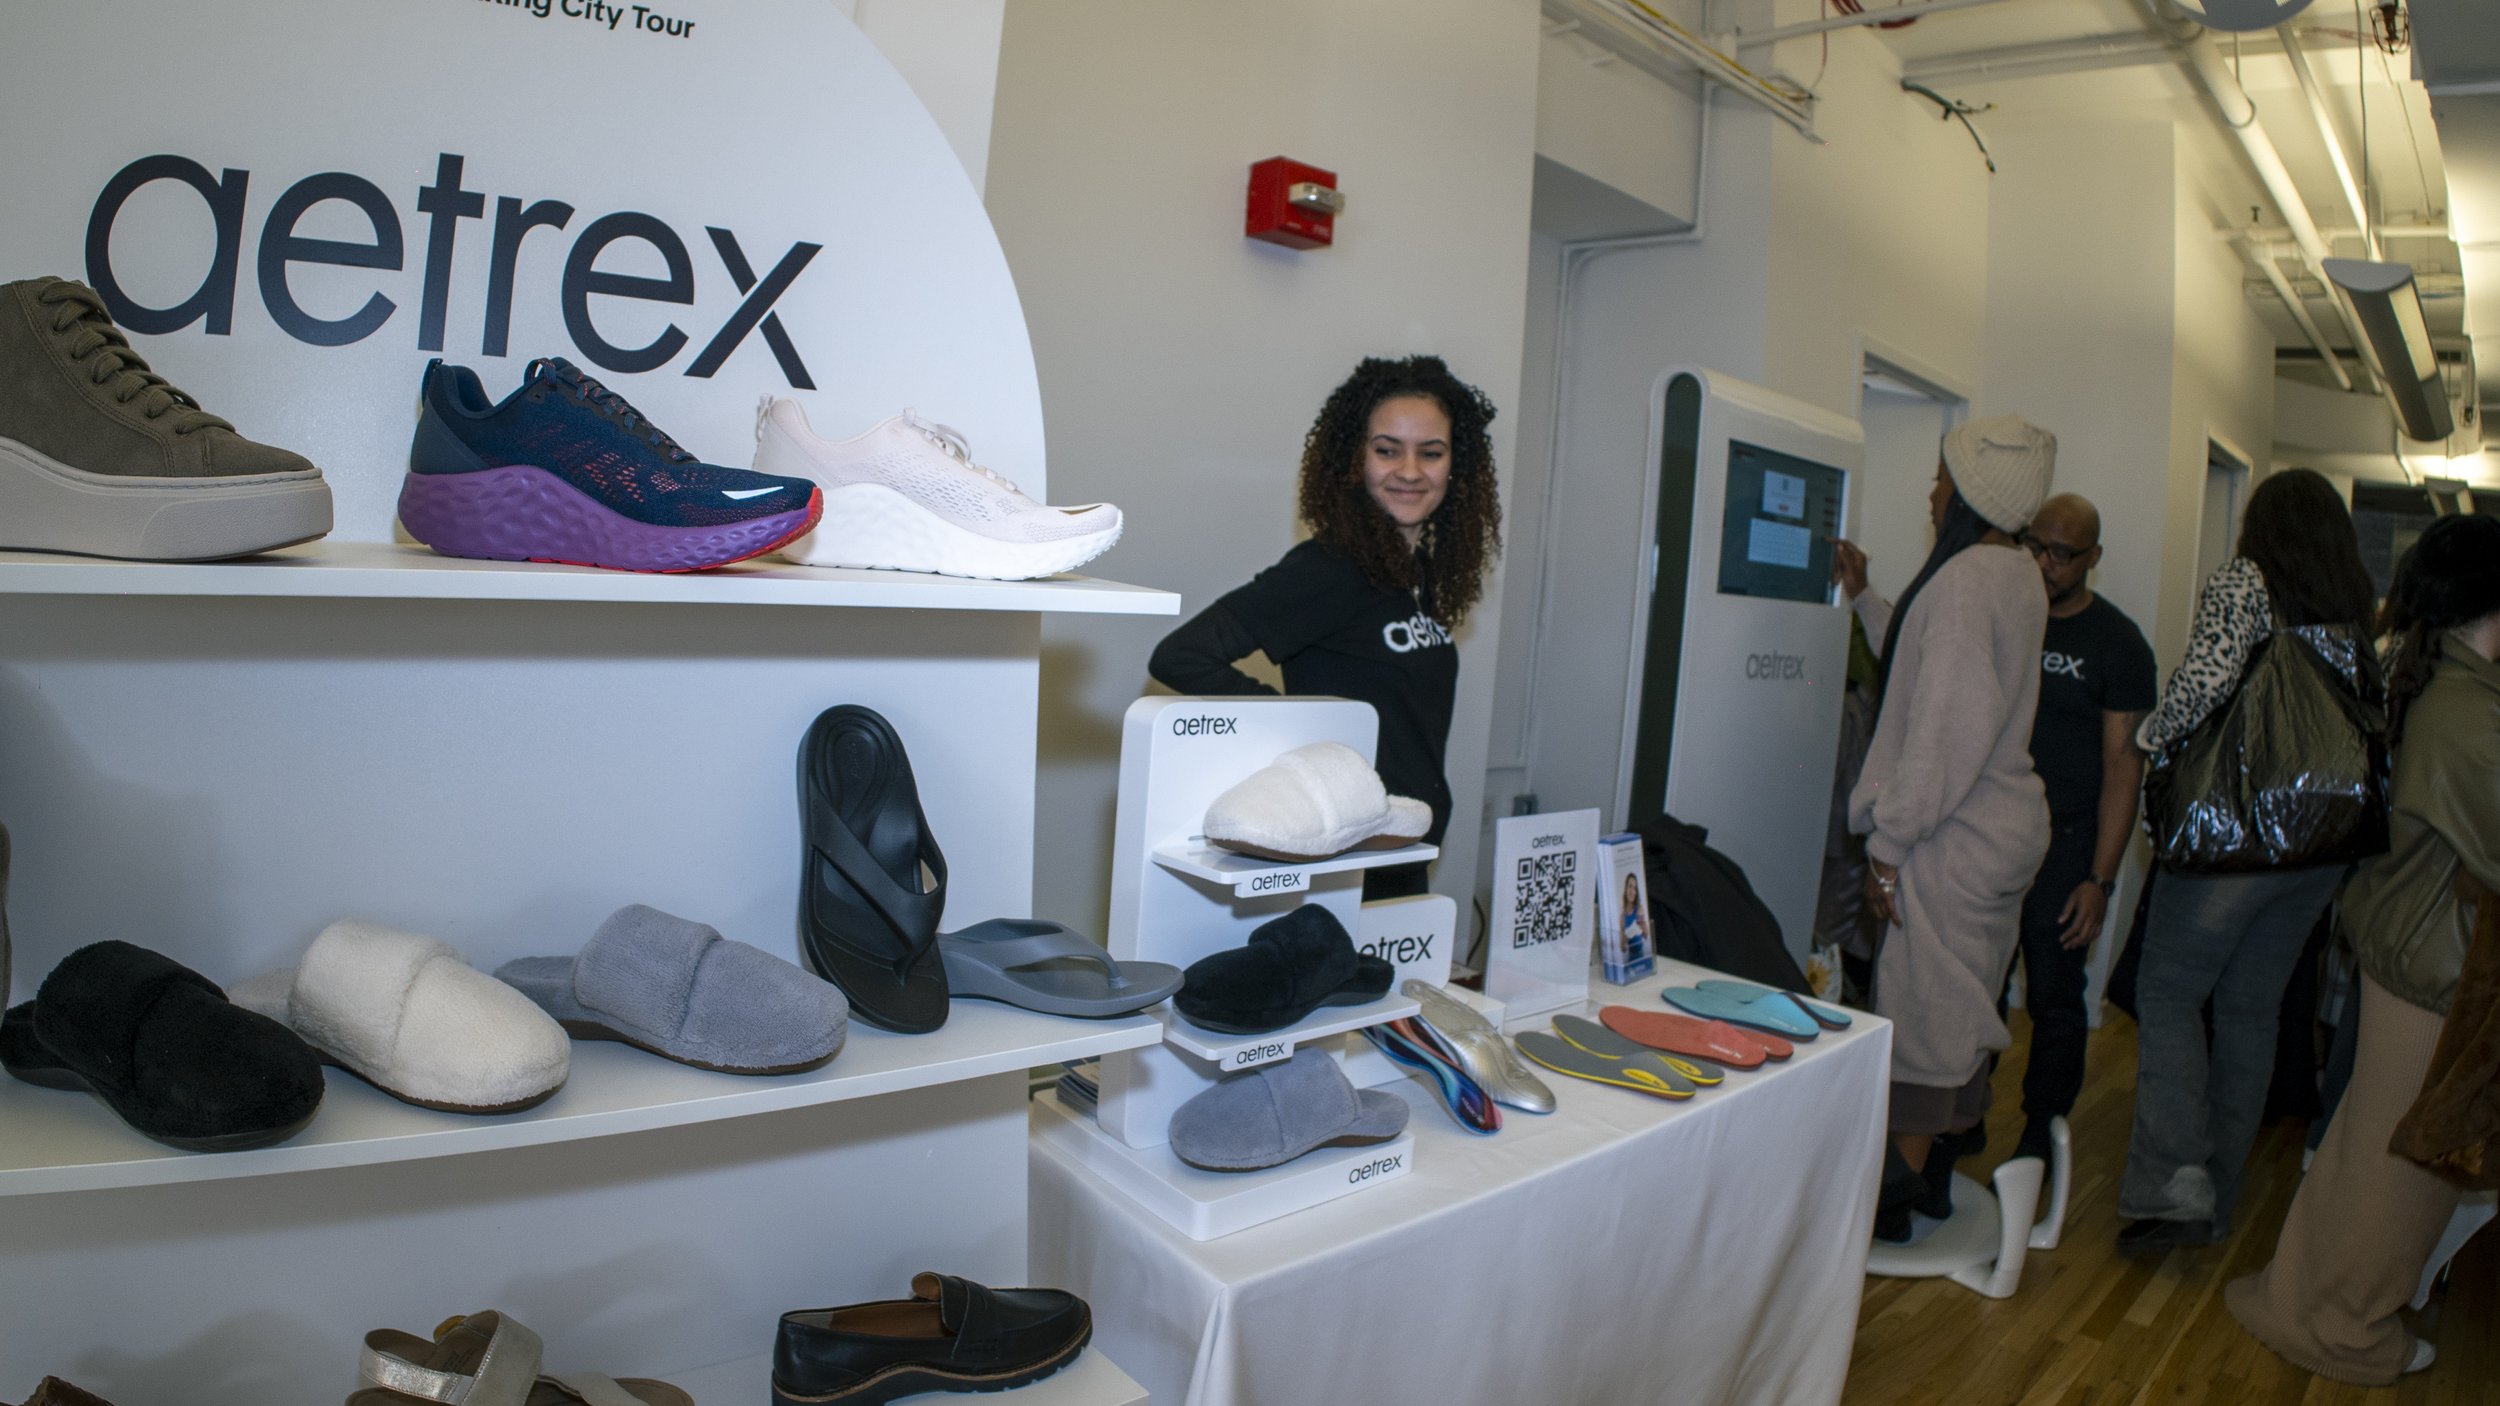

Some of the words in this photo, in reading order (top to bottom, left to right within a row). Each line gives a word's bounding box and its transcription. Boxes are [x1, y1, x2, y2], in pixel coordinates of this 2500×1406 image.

[560, 0, 624, 30] City
[632, 5, 695, 38] Tour
[85, 152, 823, 391] aetrex
[1745, 649, 1806, 680] aetrex
[1172, 714, 1238, 736] aetrex
[1251, 871, 1301, 891] aetrex
[1236, 1042, 1285, 1065] aetrex
[1348, 1153, 1402, 1184] aetrex
